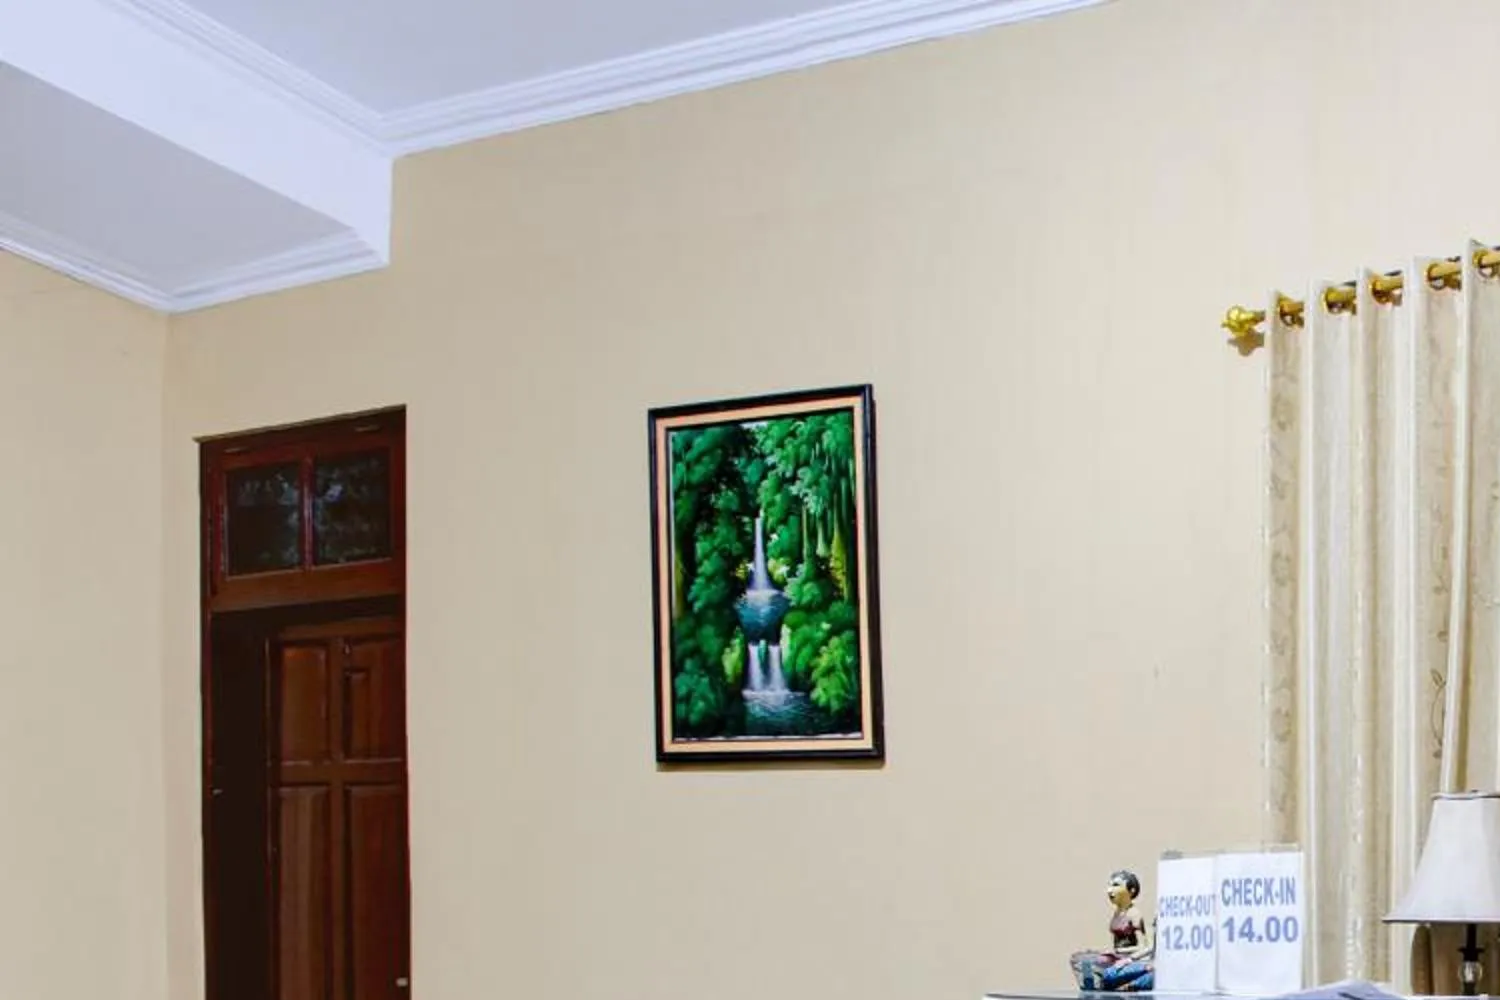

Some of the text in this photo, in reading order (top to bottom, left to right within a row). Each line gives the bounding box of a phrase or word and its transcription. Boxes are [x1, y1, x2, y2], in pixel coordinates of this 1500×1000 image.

[1221, 876, 1297, 907] CHECK-IN
[1158, 893, 1216, 918] CHECK-OUT
[1161, 924, 1214, 950] 12.00
[1222, 916, 1299, 943] 14.00
